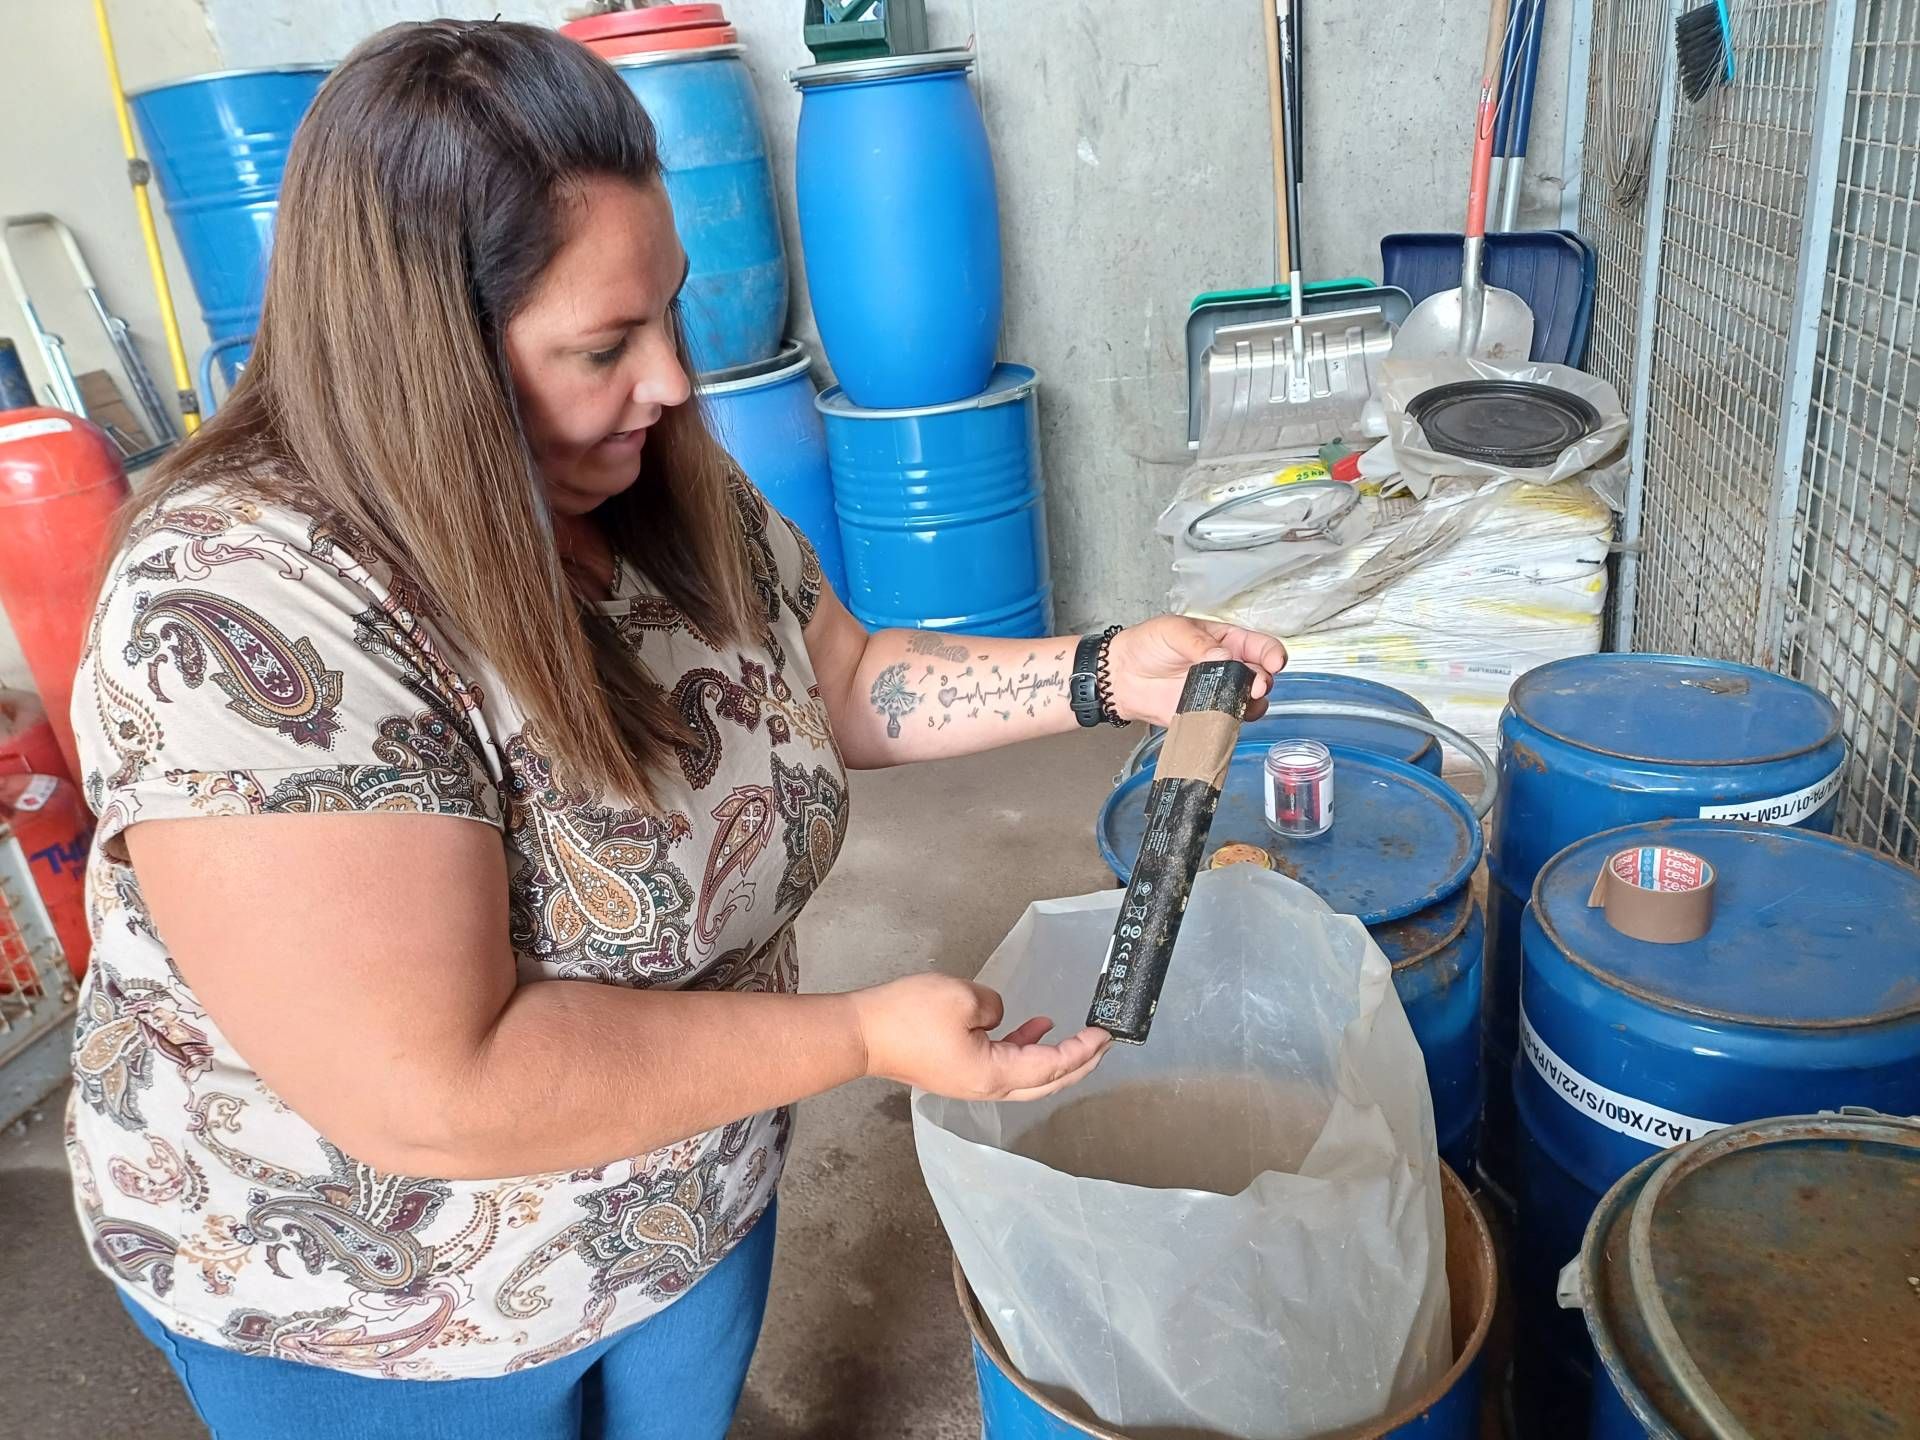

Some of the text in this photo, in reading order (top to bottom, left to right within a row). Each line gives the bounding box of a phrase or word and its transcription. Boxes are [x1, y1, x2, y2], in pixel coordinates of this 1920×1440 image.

[1031, 670, 1065, 691] family
[1664, 857, 1696, 874] tesa
[1664, 868, 1695, 885] tesa
